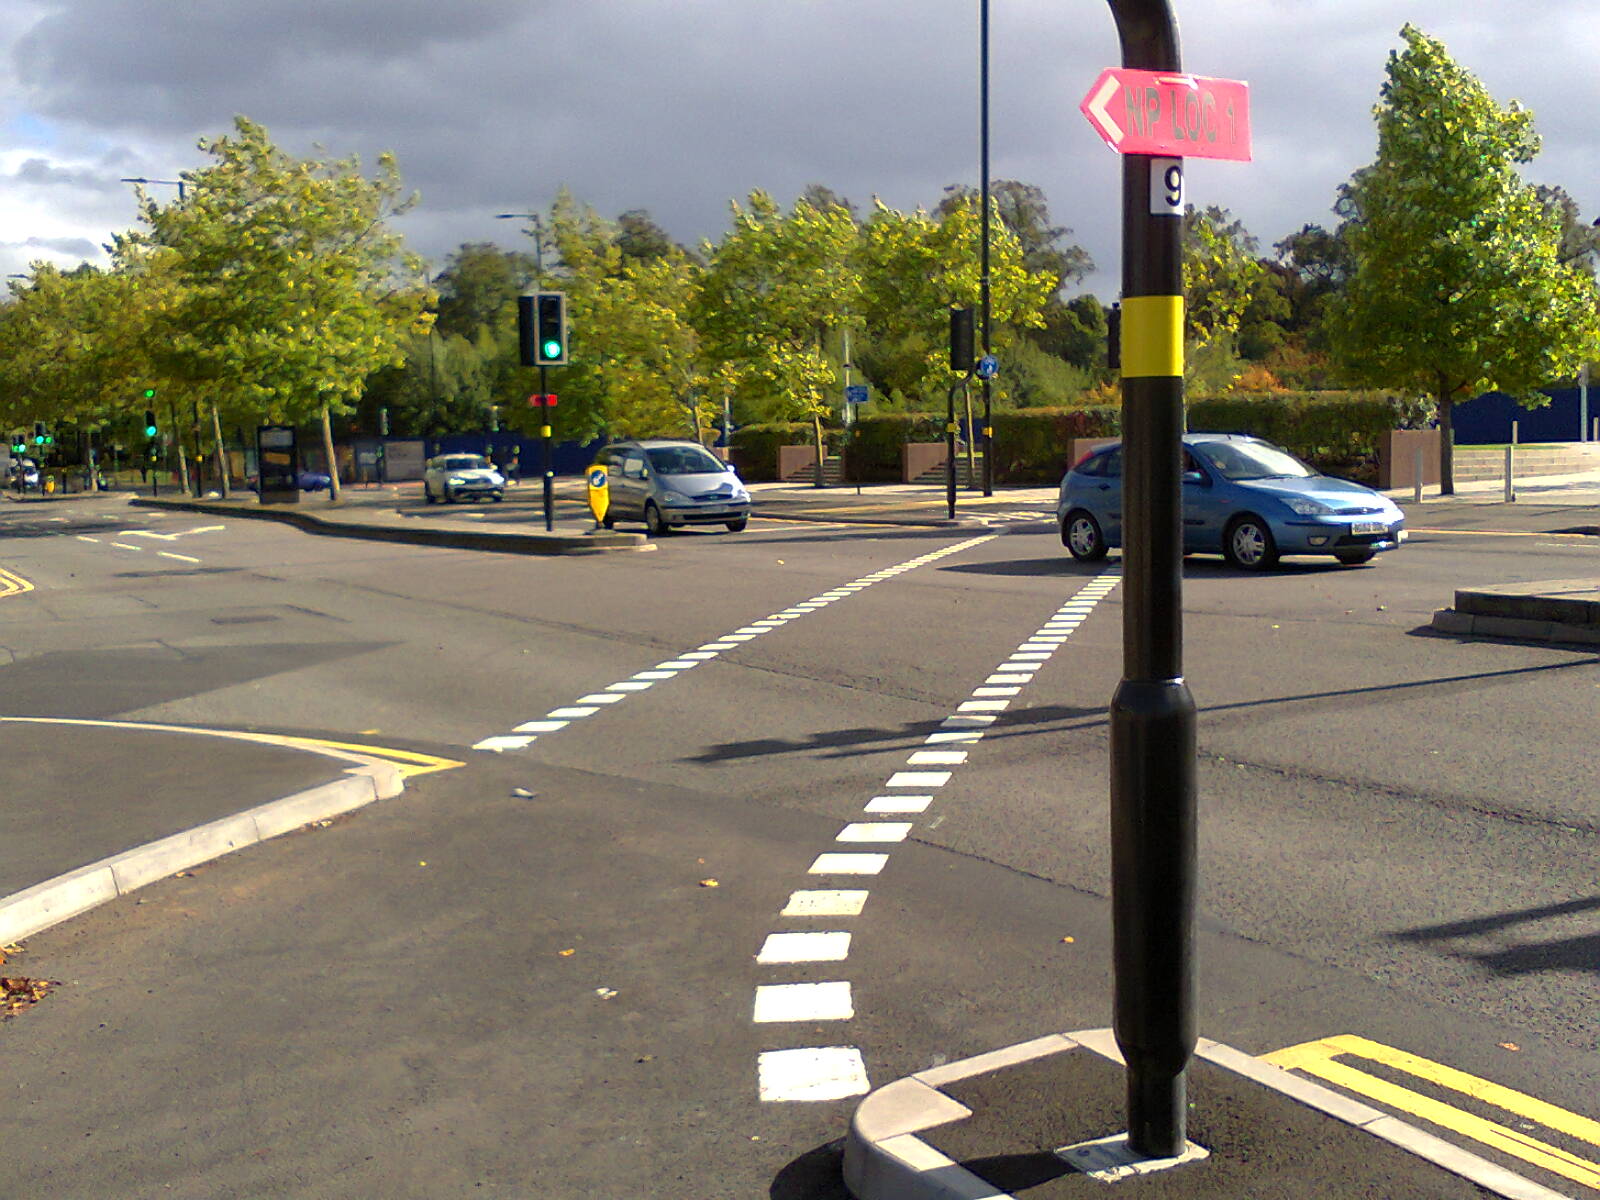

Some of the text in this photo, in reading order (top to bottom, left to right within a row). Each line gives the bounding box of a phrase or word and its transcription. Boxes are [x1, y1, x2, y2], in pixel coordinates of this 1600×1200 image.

[1125, 87, 1237, 144] NP LOC 1
[1164, 165, 1182, 206] 9
